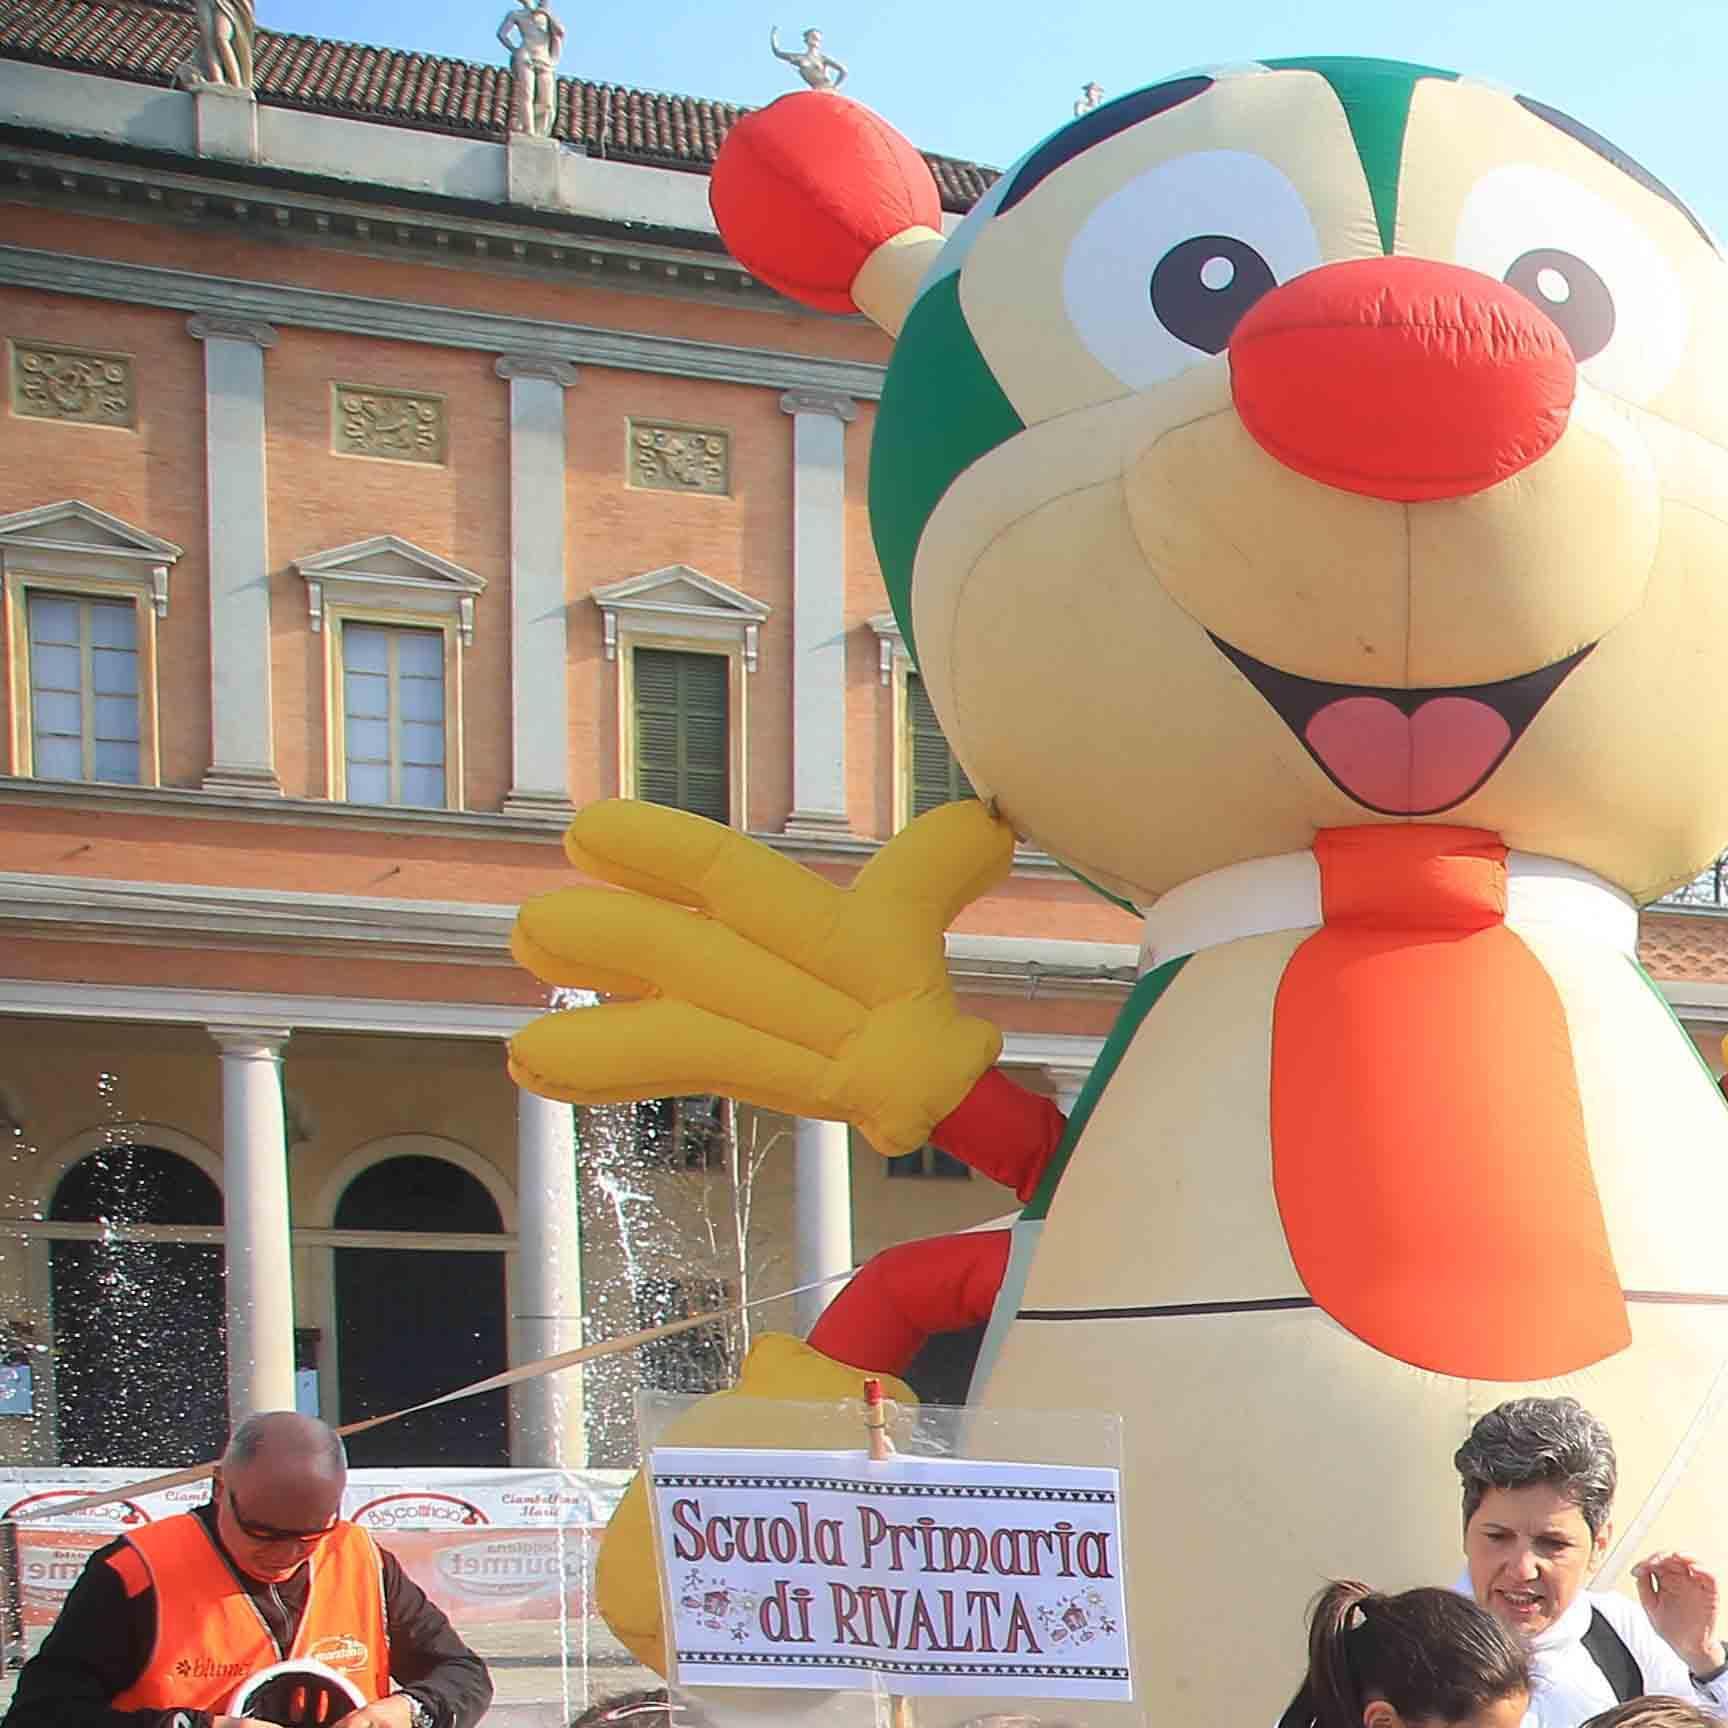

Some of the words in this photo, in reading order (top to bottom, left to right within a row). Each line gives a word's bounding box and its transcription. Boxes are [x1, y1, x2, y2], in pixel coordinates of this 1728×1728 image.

[671, 1499, 845, 1567] Scuola
[856, 1506, 1114, 1578] Primaria
[759, 1581, 816, 1643] di
[828, 1582, 1043, 1654] RIVALTA
